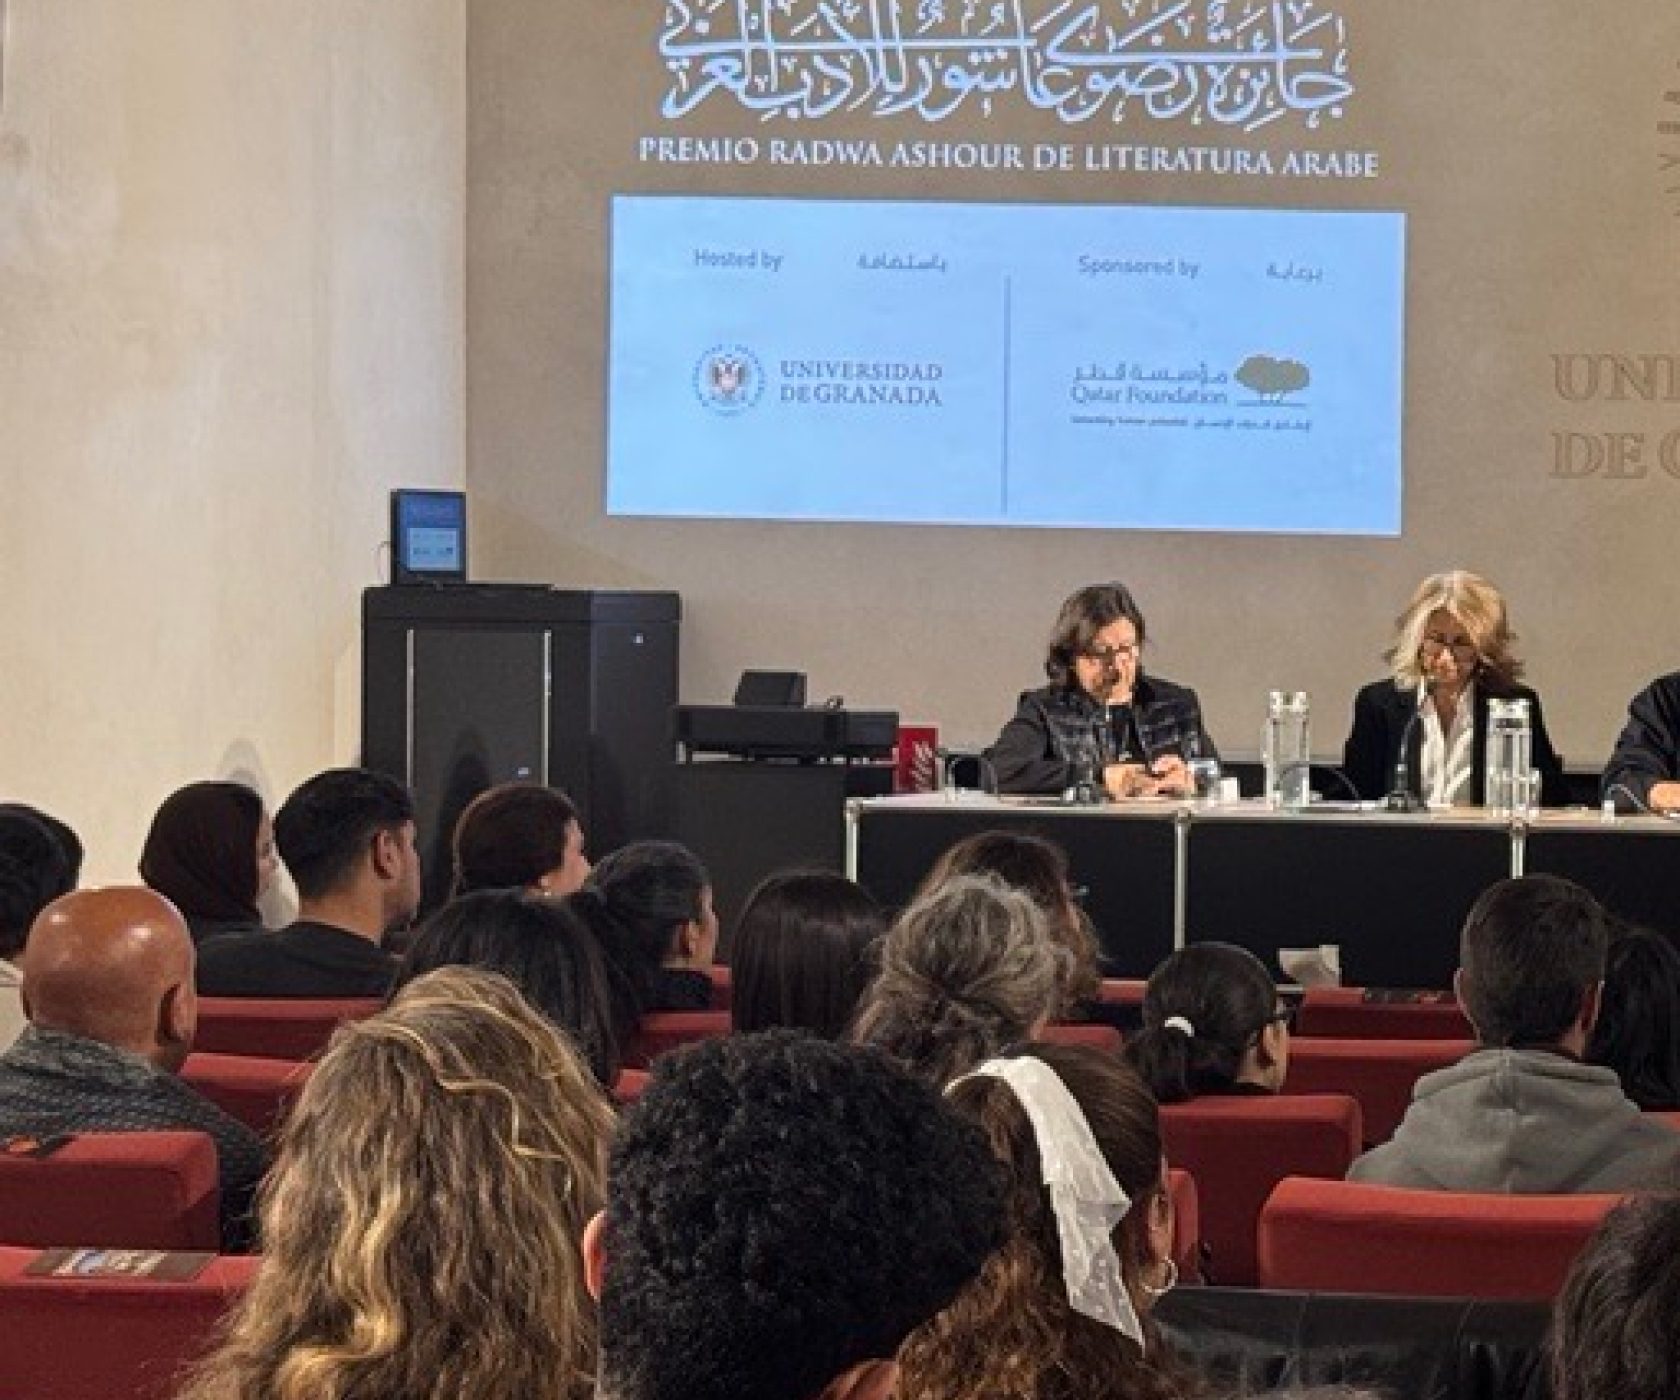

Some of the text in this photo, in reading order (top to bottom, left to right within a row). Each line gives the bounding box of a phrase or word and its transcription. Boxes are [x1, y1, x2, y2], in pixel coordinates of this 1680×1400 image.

[639, 136, 1379, 178] PREMIO RADWA ASHOUR DE LITERATURA ARABE
[694, 249, 784, 273] Hosted by
[1078, 255, 1200, 280] Sponsored by
[780, 360, 943, 381] UNIVERSIDAD
[780, 384, 943, 407] DE GRANADA
[1548, 430, 1648, 480] DE
